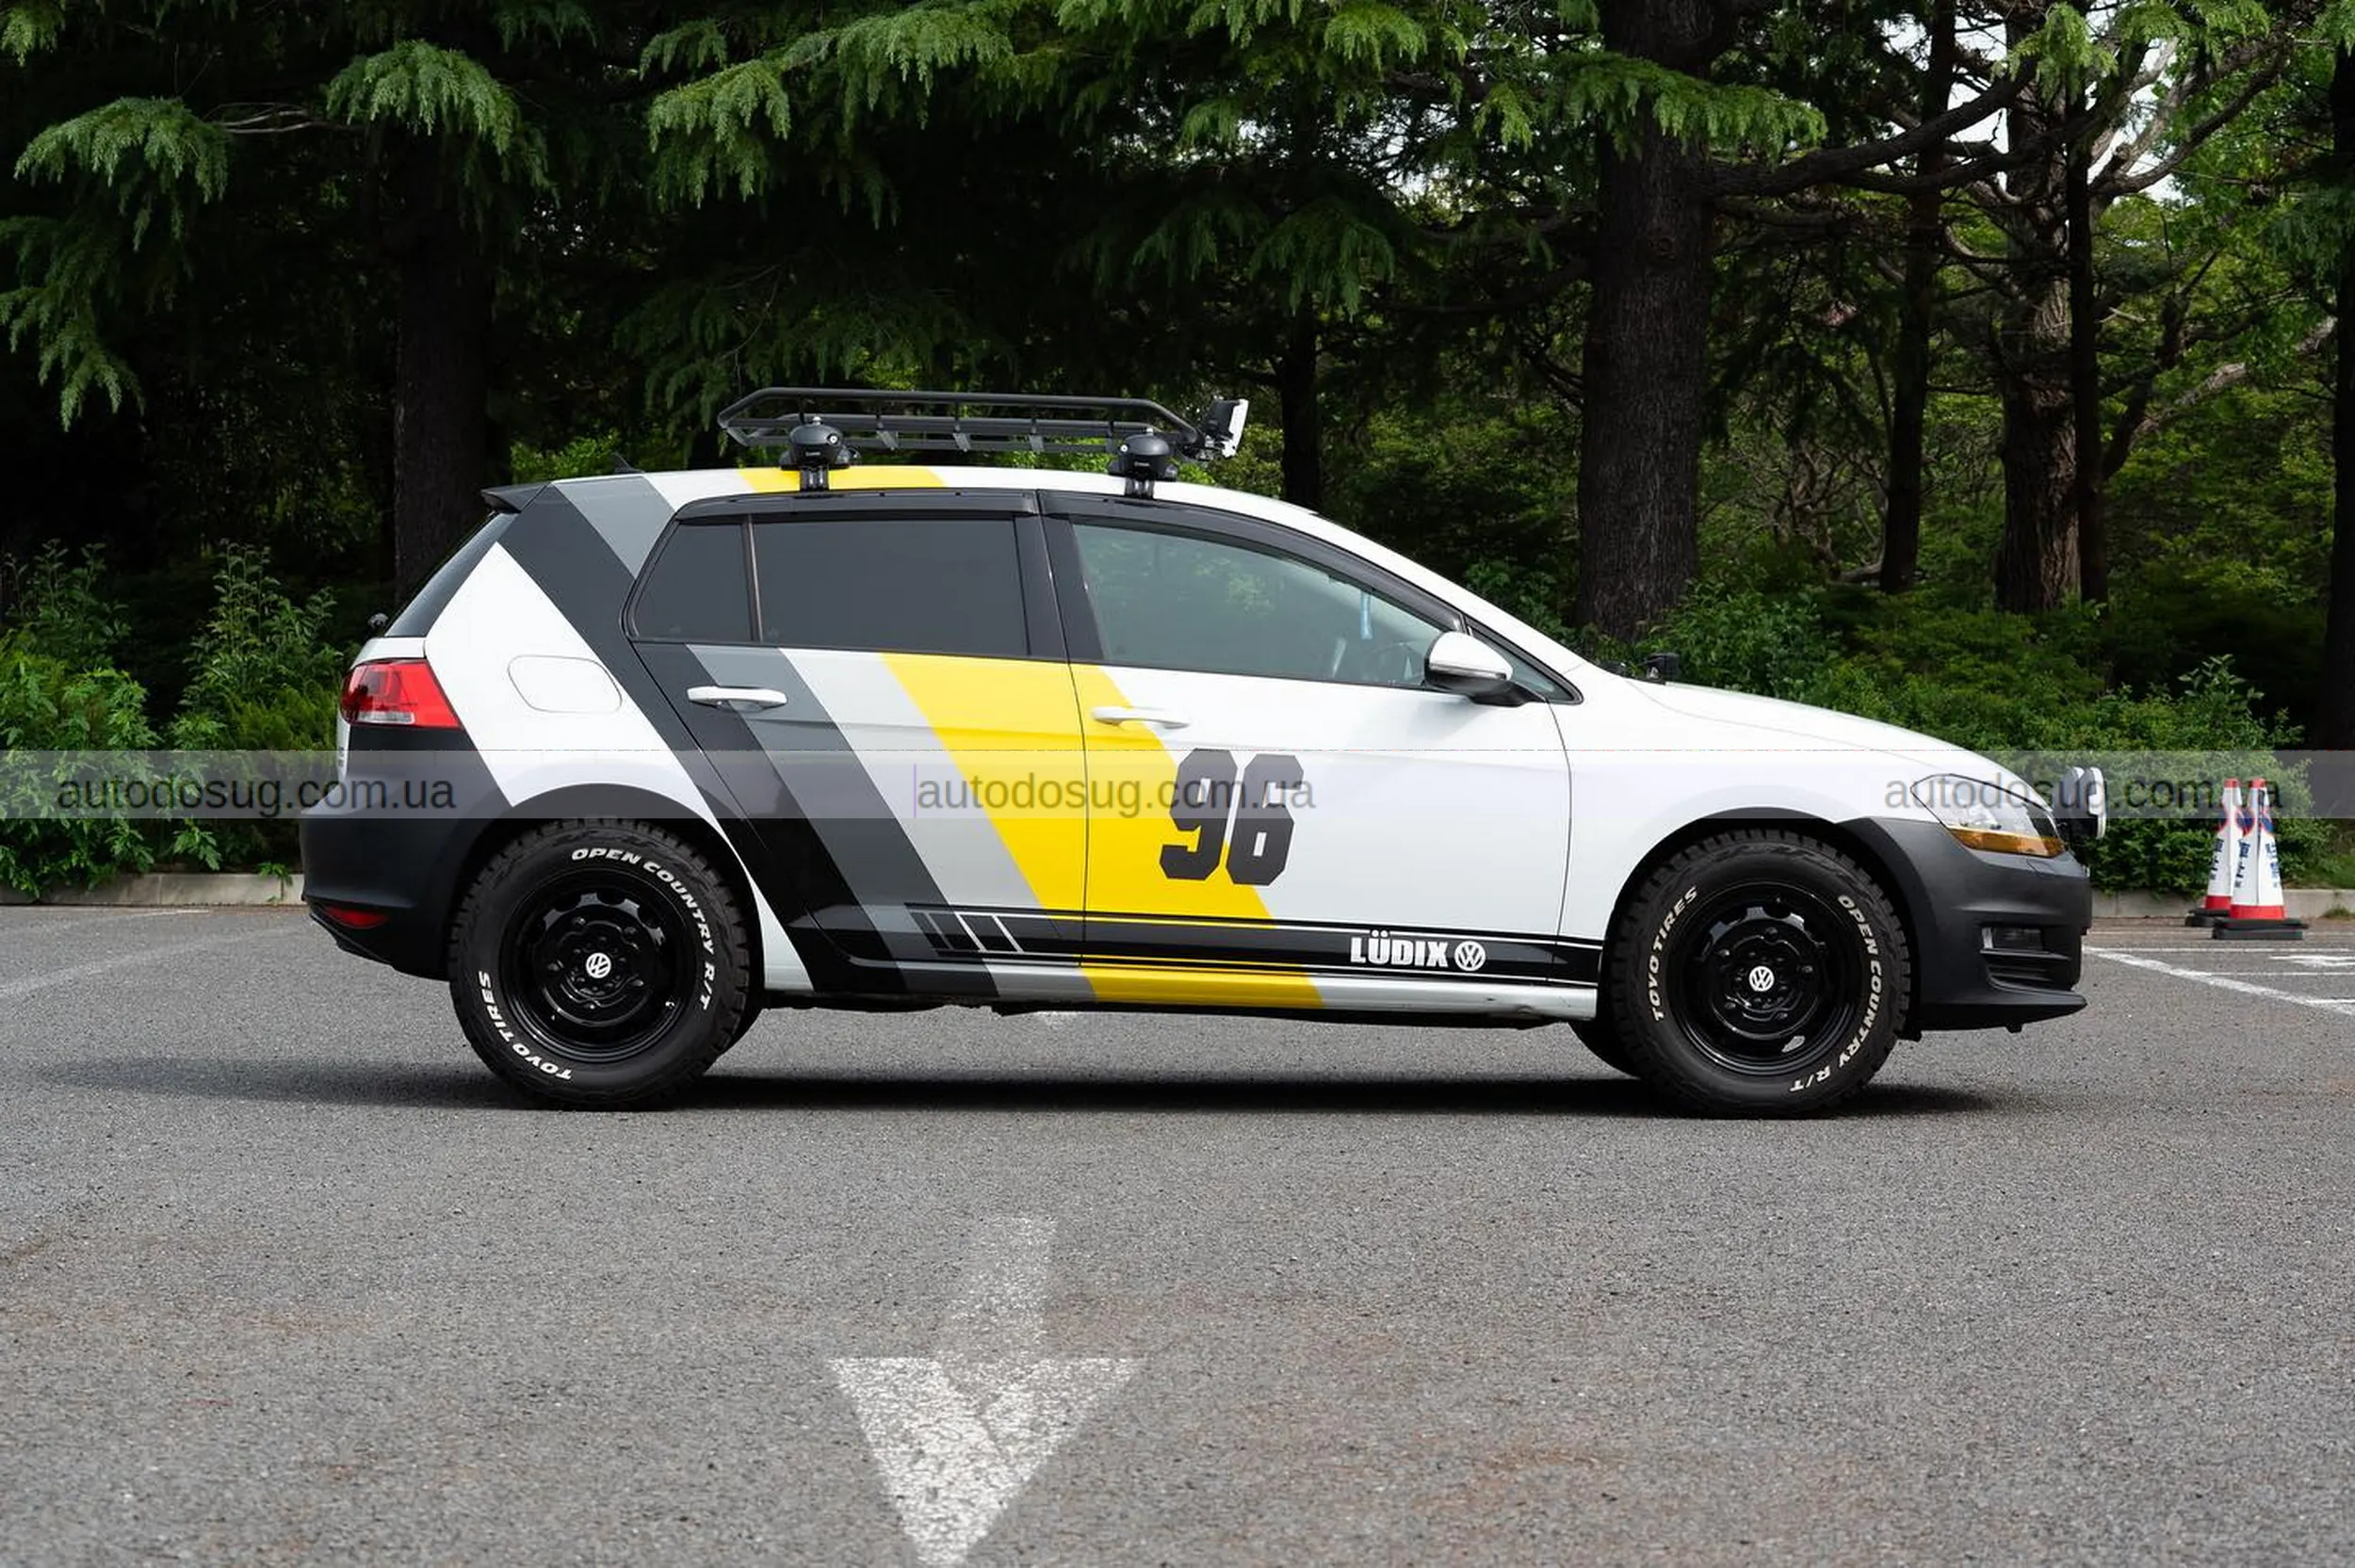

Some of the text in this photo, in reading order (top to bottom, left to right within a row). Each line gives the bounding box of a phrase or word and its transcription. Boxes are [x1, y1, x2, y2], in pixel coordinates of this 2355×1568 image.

[1159, 748, 1304, 886] 96
[571, 848, 716, 1010] OPEN COUNTRY R/T
[1349, 929, 1449, 968] LÜDIX
[1648, 886, 1697, 1022] TOYO TIRES
[1789, 895, 1883, 1092] OPEN COUNTRY R/T
[478, 970, 573, 1080] TOYO TIRES
